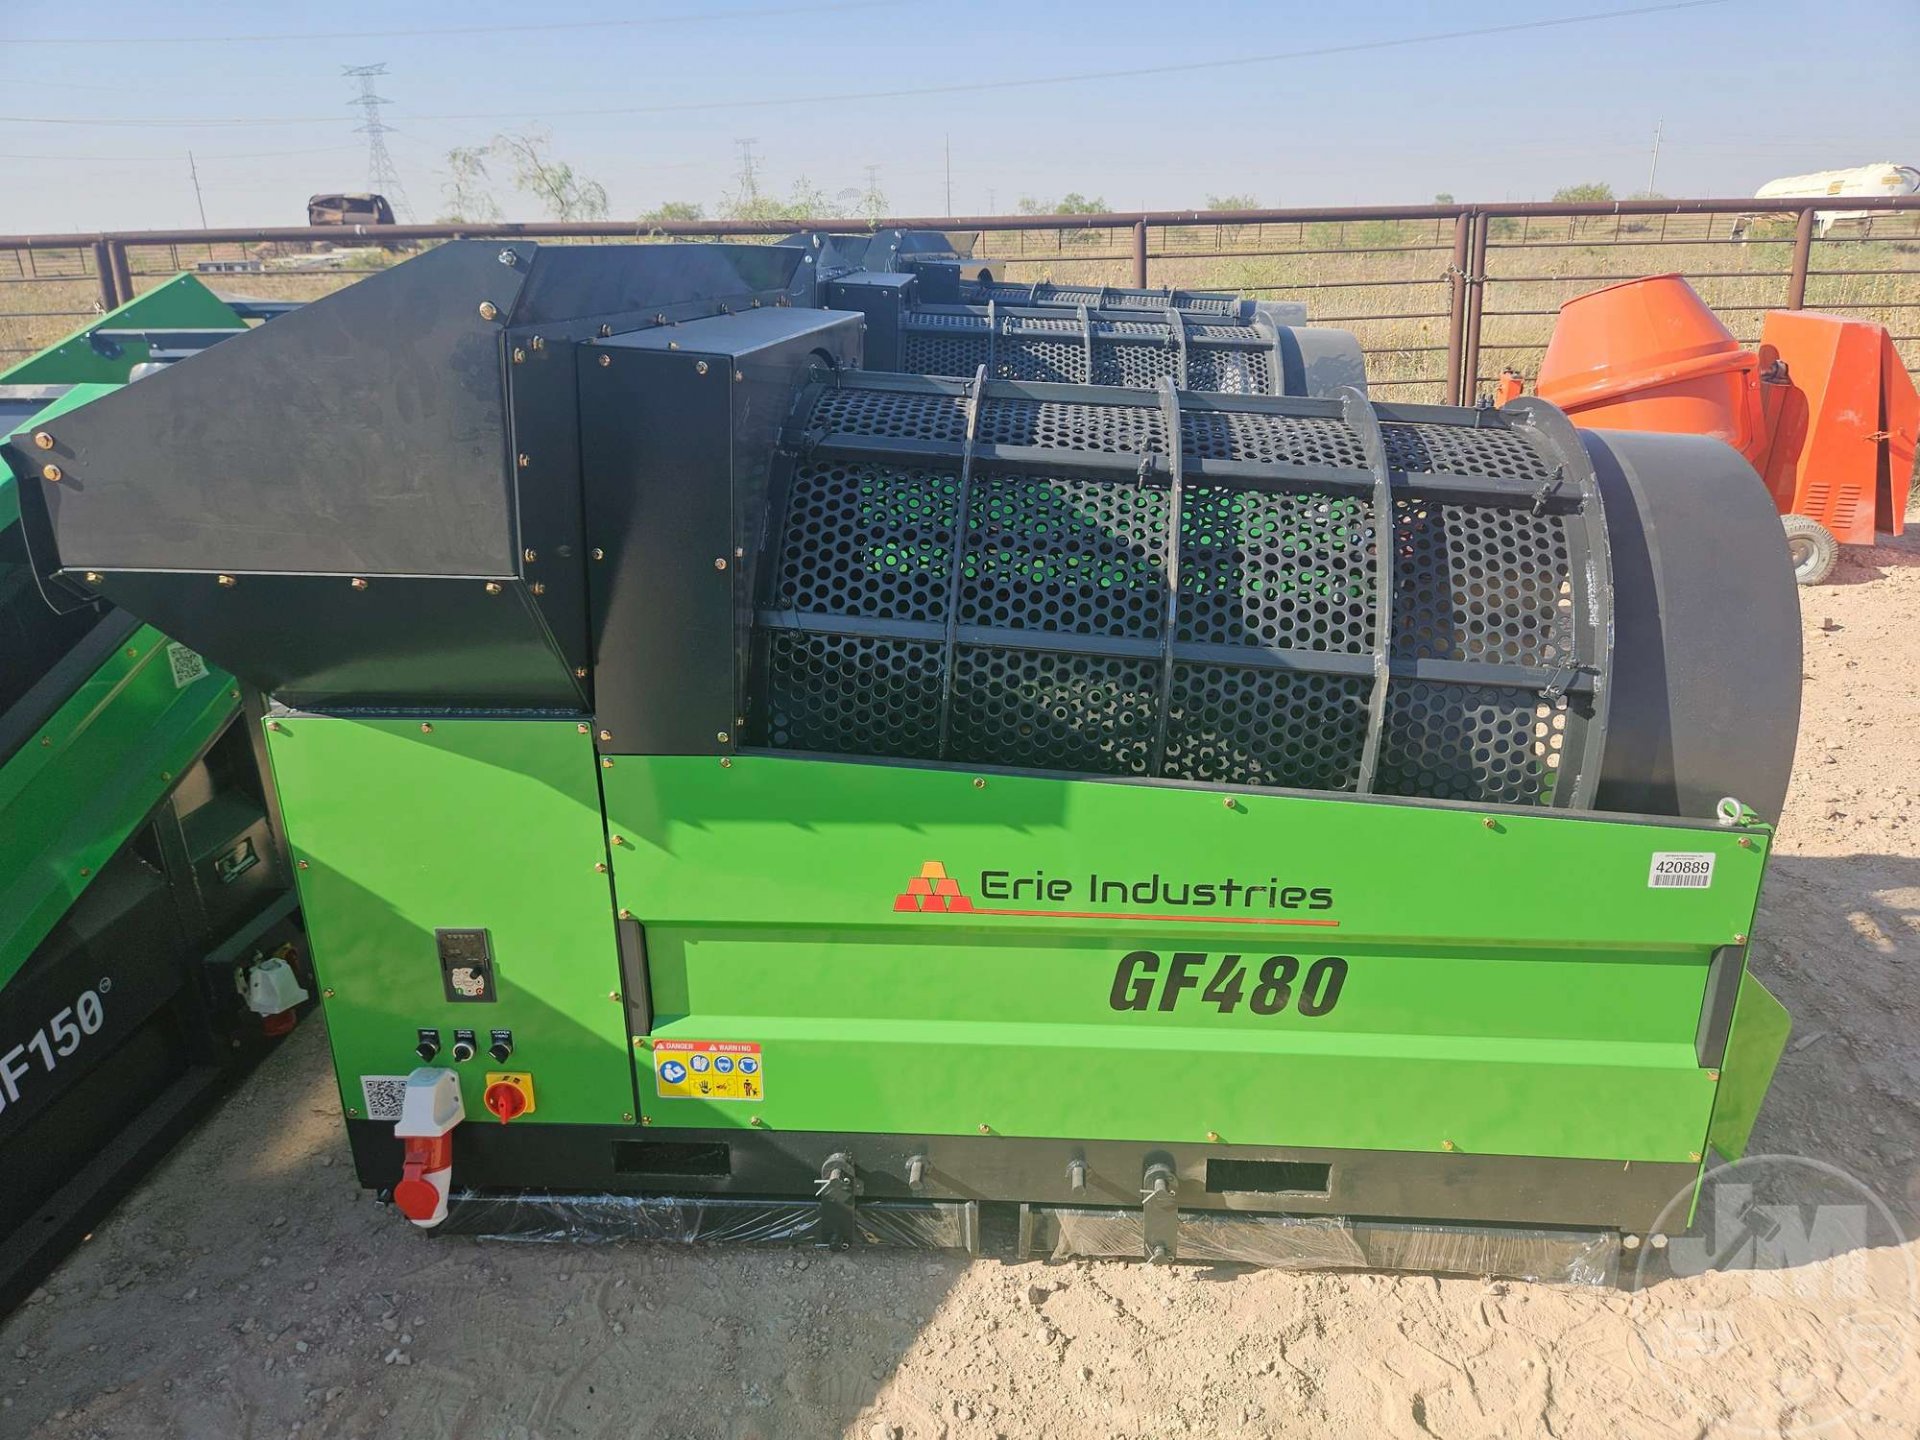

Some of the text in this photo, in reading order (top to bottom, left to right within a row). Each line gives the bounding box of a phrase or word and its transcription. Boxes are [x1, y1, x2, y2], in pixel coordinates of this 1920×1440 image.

[1656, 861, 1710, 873] 420889
[982, 869, 1333, 910] Erie Industries
[1108, 950, 1349, 1017] GF480
